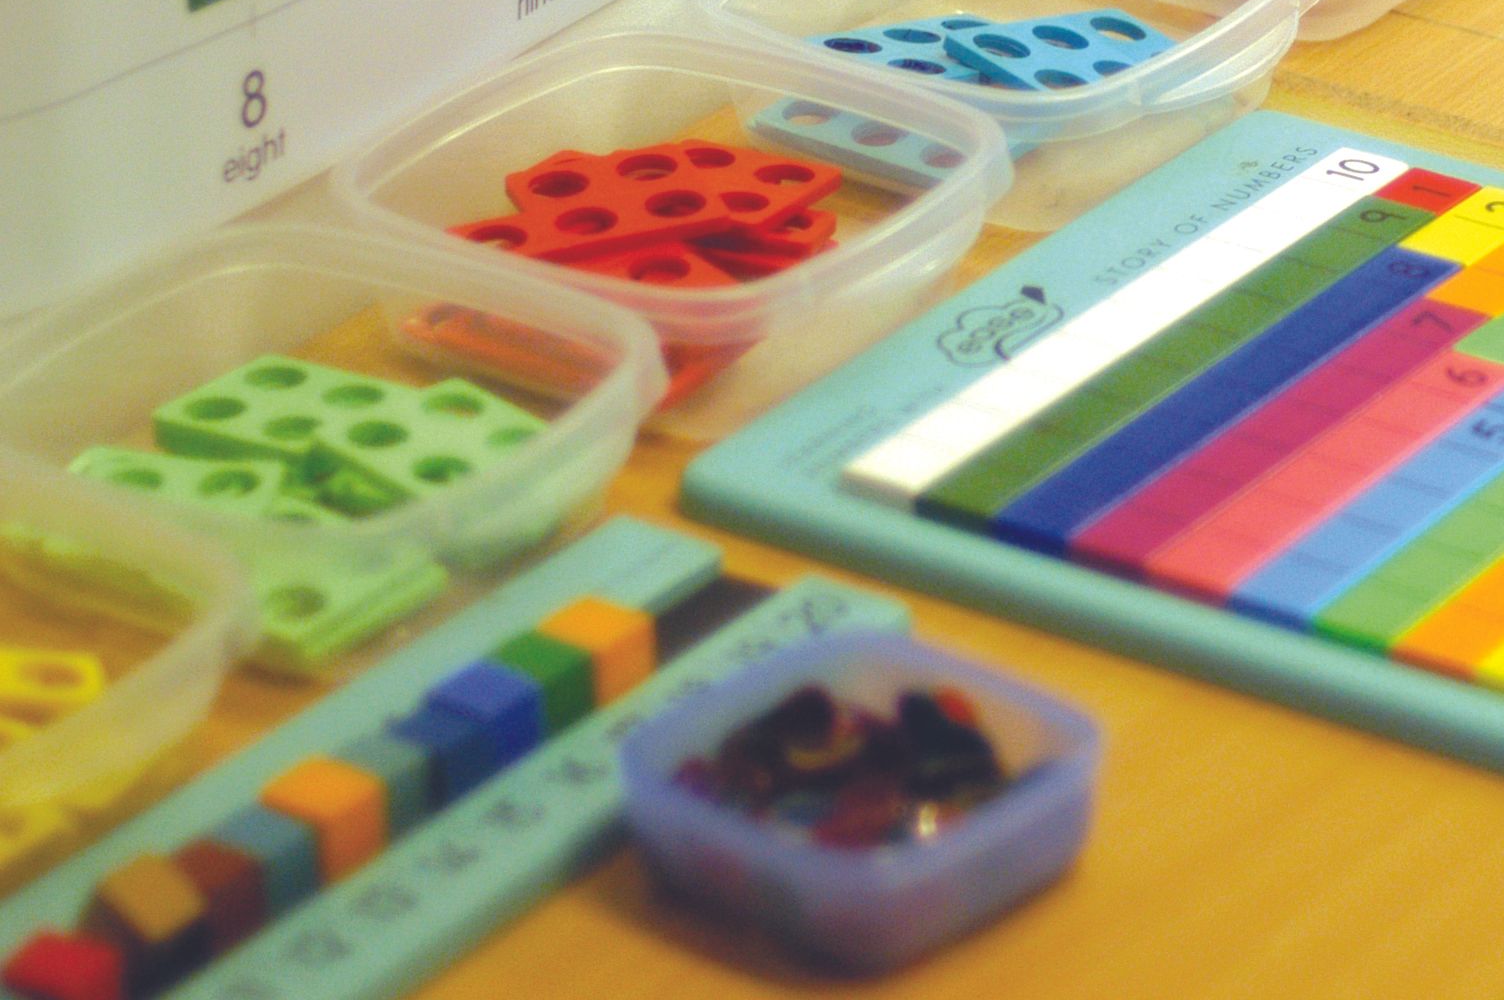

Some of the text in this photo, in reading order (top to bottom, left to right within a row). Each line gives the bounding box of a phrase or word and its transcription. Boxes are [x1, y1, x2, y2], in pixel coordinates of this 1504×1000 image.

[242, 69, 267, 128] 8
[223, 128, 285, 183] eight
[1326, 159, 1380, 182] 10
[1412, 184, 1452, 198] 1
[1095, 145, 1318, 286] STORY OF NUMBERS
[1360, 208, 1408, 225] 9
[1411, 310, 1454, 331] 7
[1447, 366, 1487, 388] 6
